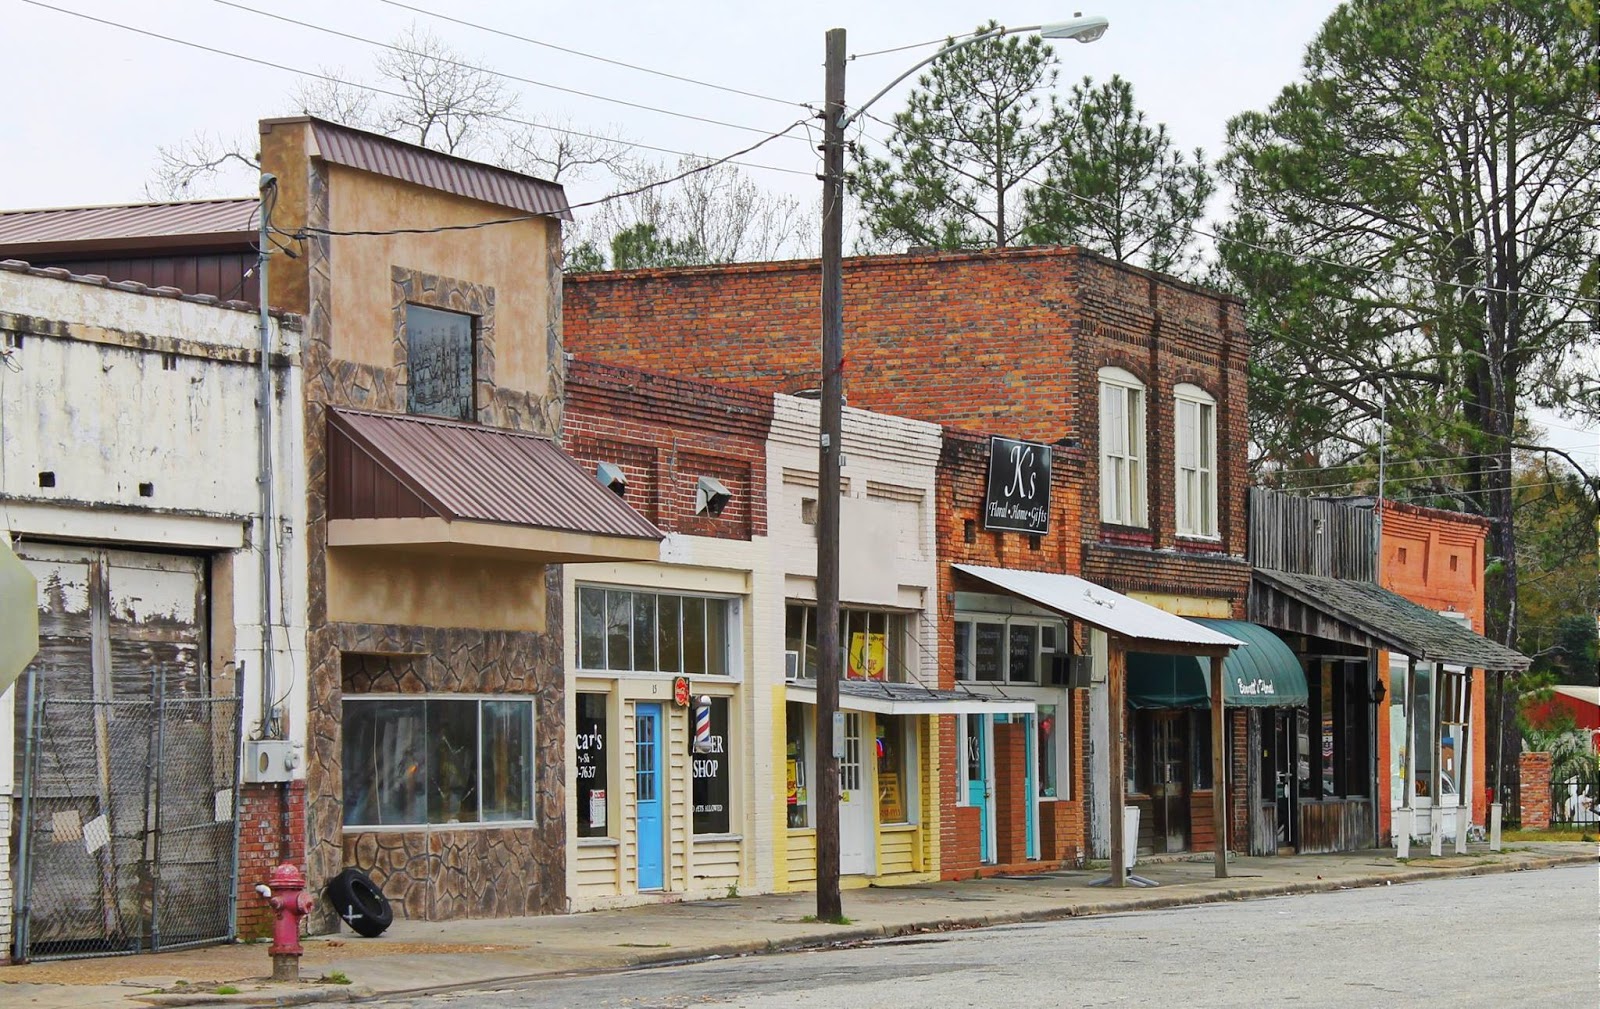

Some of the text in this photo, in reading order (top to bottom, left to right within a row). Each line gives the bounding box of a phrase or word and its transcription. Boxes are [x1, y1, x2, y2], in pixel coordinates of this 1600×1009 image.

[1004, 445, 1037, 500] K's
[988, 500, 1047, 528] Floral Home Gifts
[693, 759, 719, 778] SHOP
